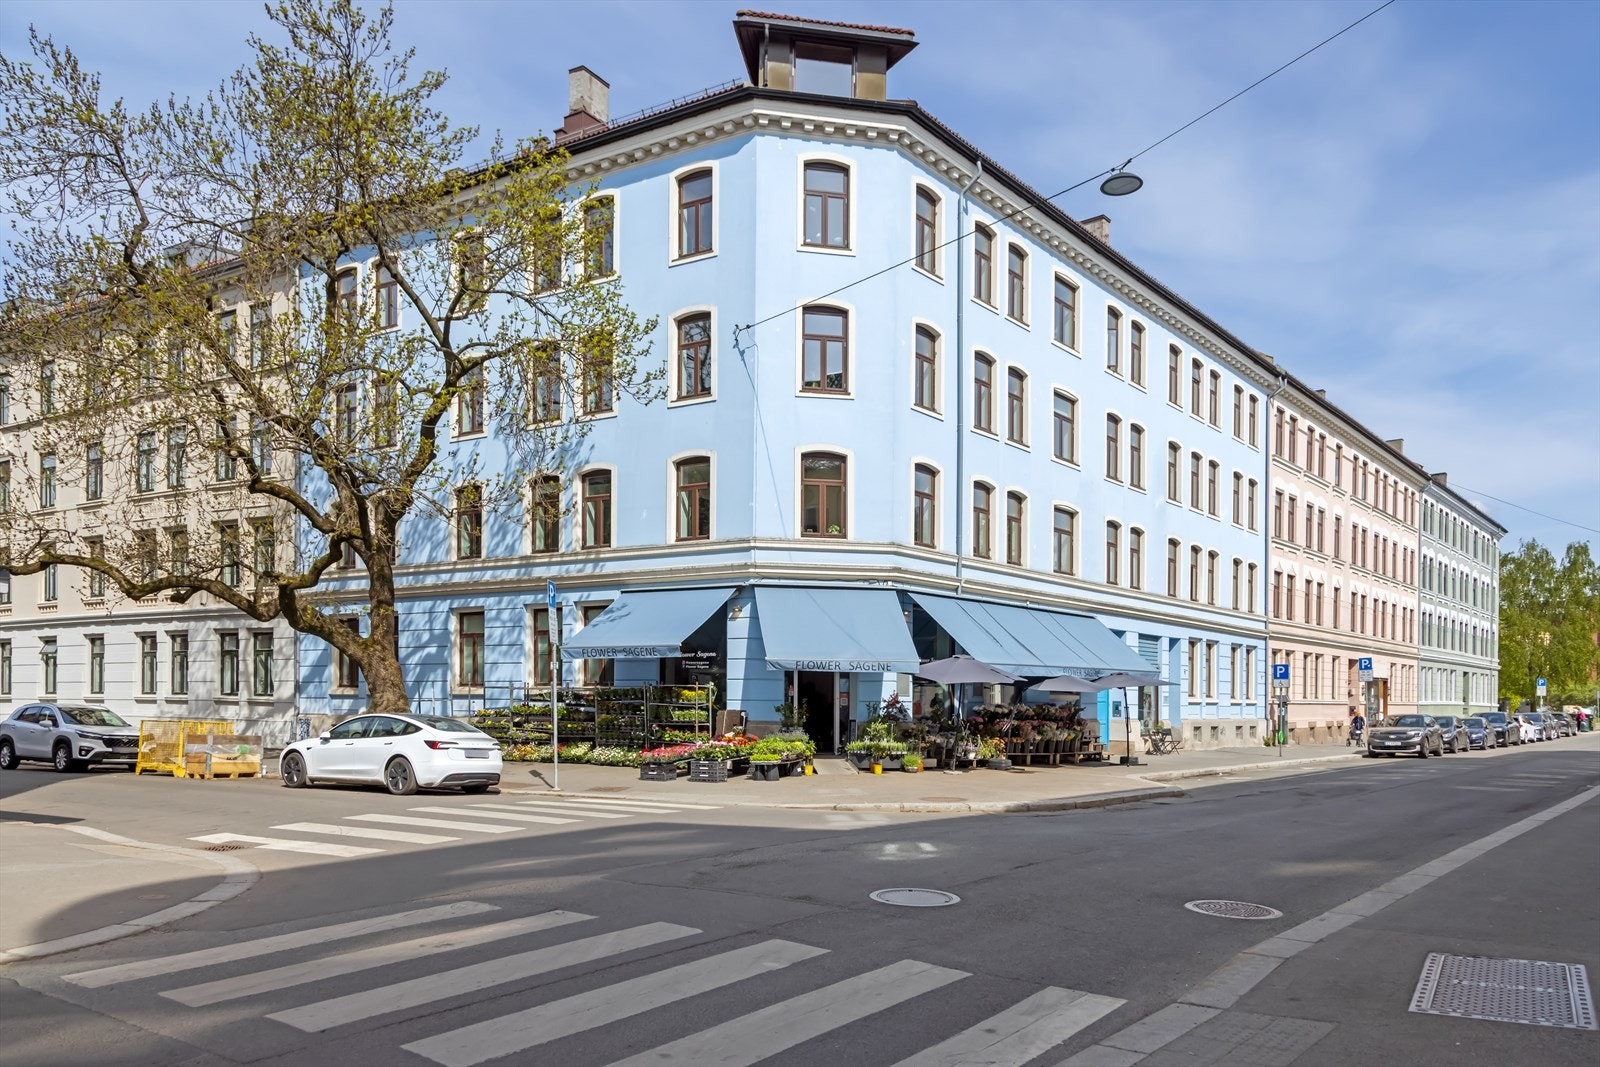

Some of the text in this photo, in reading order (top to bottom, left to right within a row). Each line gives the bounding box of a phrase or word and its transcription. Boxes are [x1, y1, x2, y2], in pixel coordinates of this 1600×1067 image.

[581, 646, 658, 658] FLOWER SAGENE
[795, 660, 892, 672] FLOWER SAGENE
[1362, 660, 1369, 669] P
[1276, 666, 1285, 678] P
